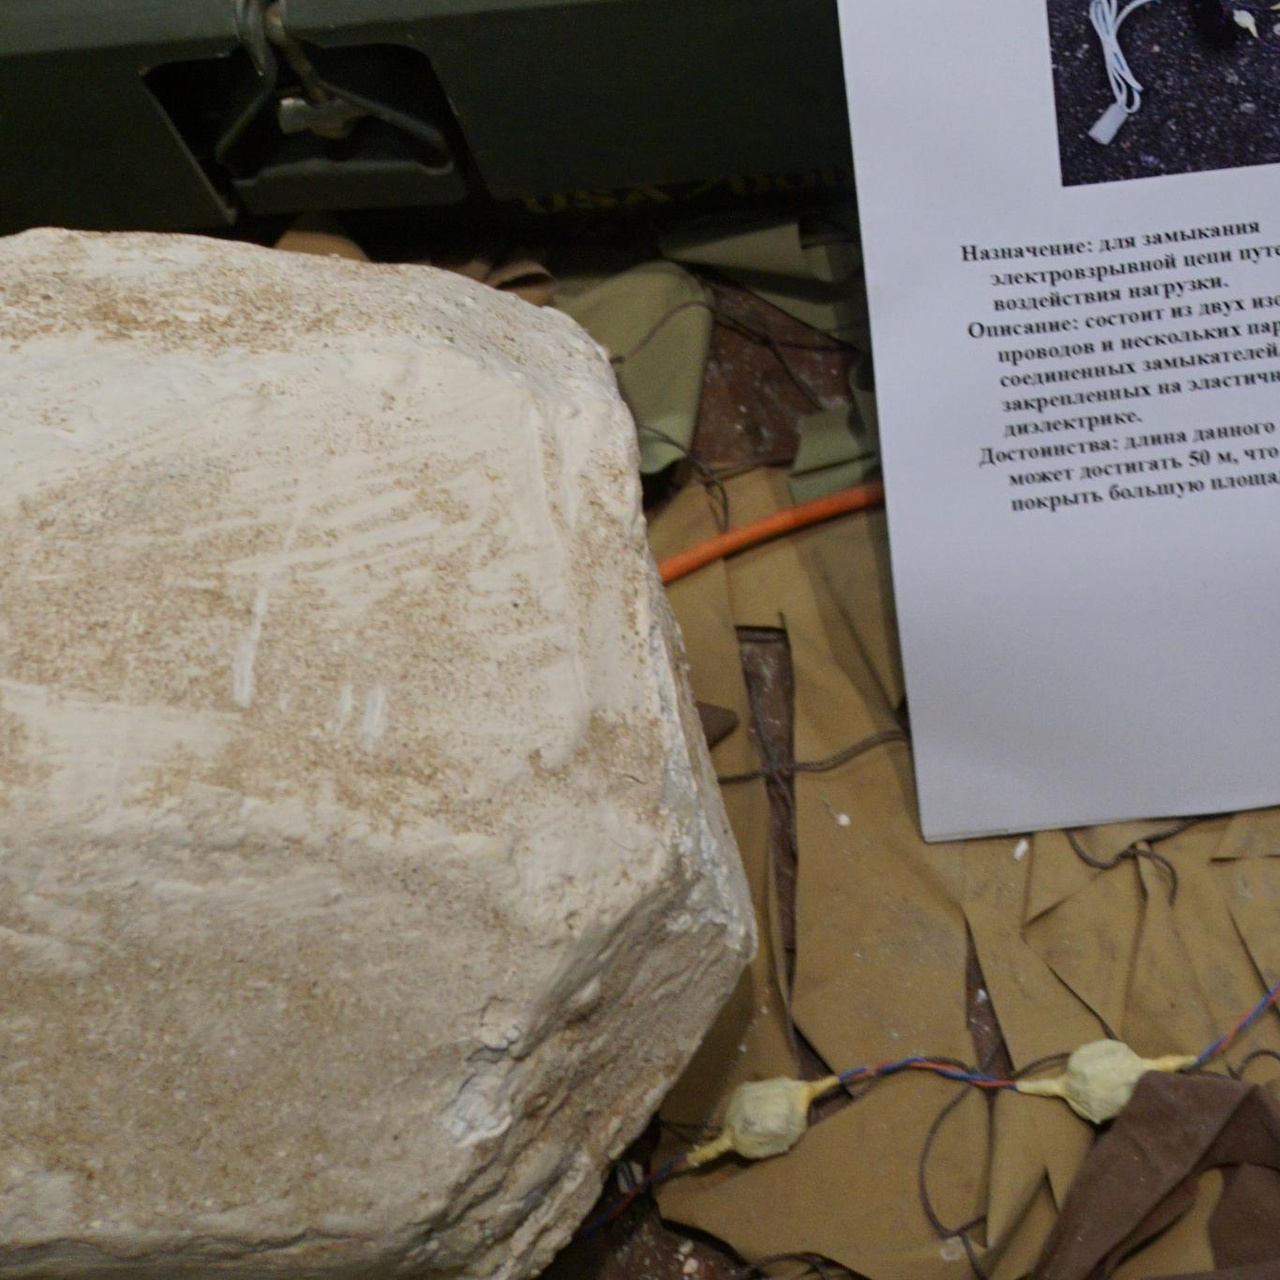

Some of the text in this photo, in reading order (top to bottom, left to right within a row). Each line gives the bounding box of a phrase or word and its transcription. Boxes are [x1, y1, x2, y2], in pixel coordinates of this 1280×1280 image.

[1099, 236, 1137, 253] для
[1142, 221, 1261, 246] замыкания
[1183, 250, 1233, 268] цепи
[1128, 277, 1229, 299] нагрузки.
[967, 318, 1079, 339] Описание:
[1084, 308, 1165, 329] состоит
[1170, 305, 1193, 319] из
[1198, 299, 1246, 317] двух
[998, 343, 1095, 366] проводов
[1100, 340, 1114, 352] и
[1157, 382, 1182, 395] на
[1124, 431, 1188, 450] длина
[1192, 422, 1276, 443] данного
[1009, 468, 1074, 486] может
[1080, 457, 1183, 480] достигать
[1188, 449, 1211, 467] 50
[1217, 451, 1239, 465] м,
[1243, 447, 1280, 461] что
[1011, 491, 1104, 512] покрыть
[1108, 480, 1205, 501] большую
